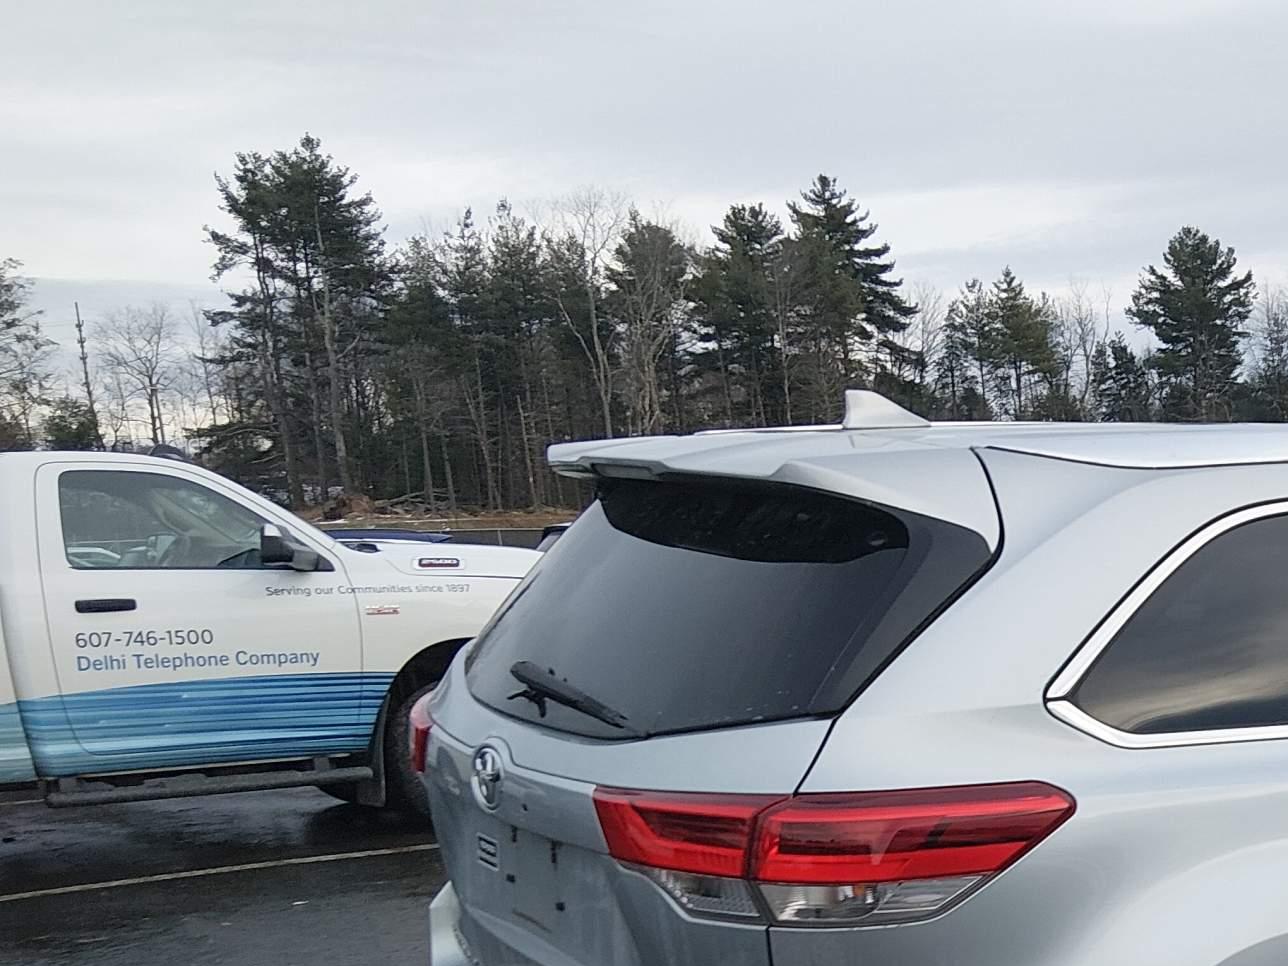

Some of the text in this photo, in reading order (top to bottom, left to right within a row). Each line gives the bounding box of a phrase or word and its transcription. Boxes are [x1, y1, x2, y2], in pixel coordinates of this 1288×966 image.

[265, 583, 470, 597] Serving our Communities since 1897
[75, 629, 214, 649] 607-746-1500
[76, 650, 320, 672] Delhi Telephone Company
